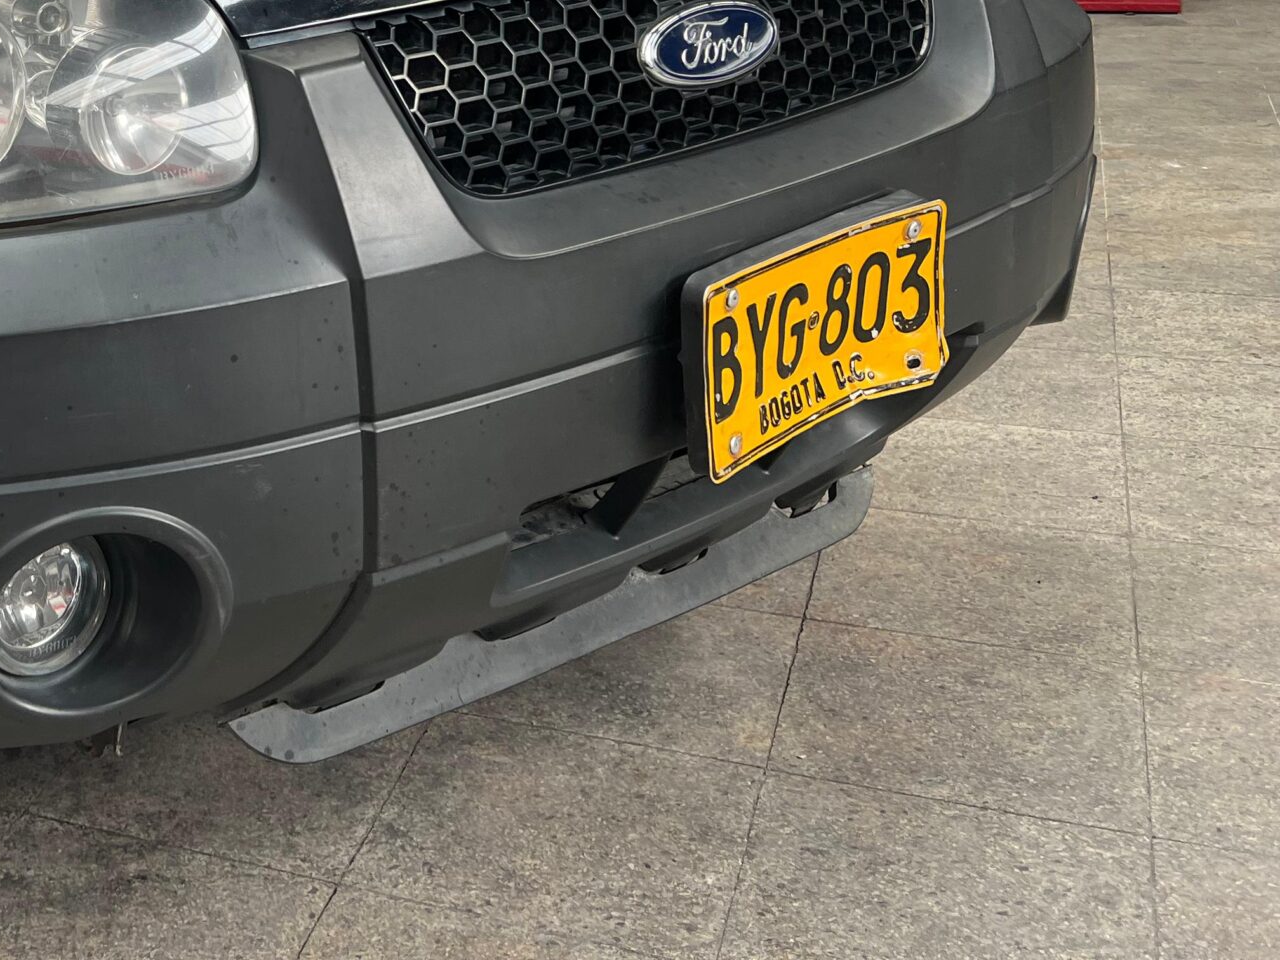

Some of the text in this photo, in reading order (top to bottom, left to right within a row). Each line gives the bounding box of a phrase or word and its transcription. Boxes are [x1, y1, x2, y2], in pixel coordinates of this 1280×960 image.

[681, 16, 753, 70] Ford
[759, 353, 875, 435] BOGOTA D.C.
